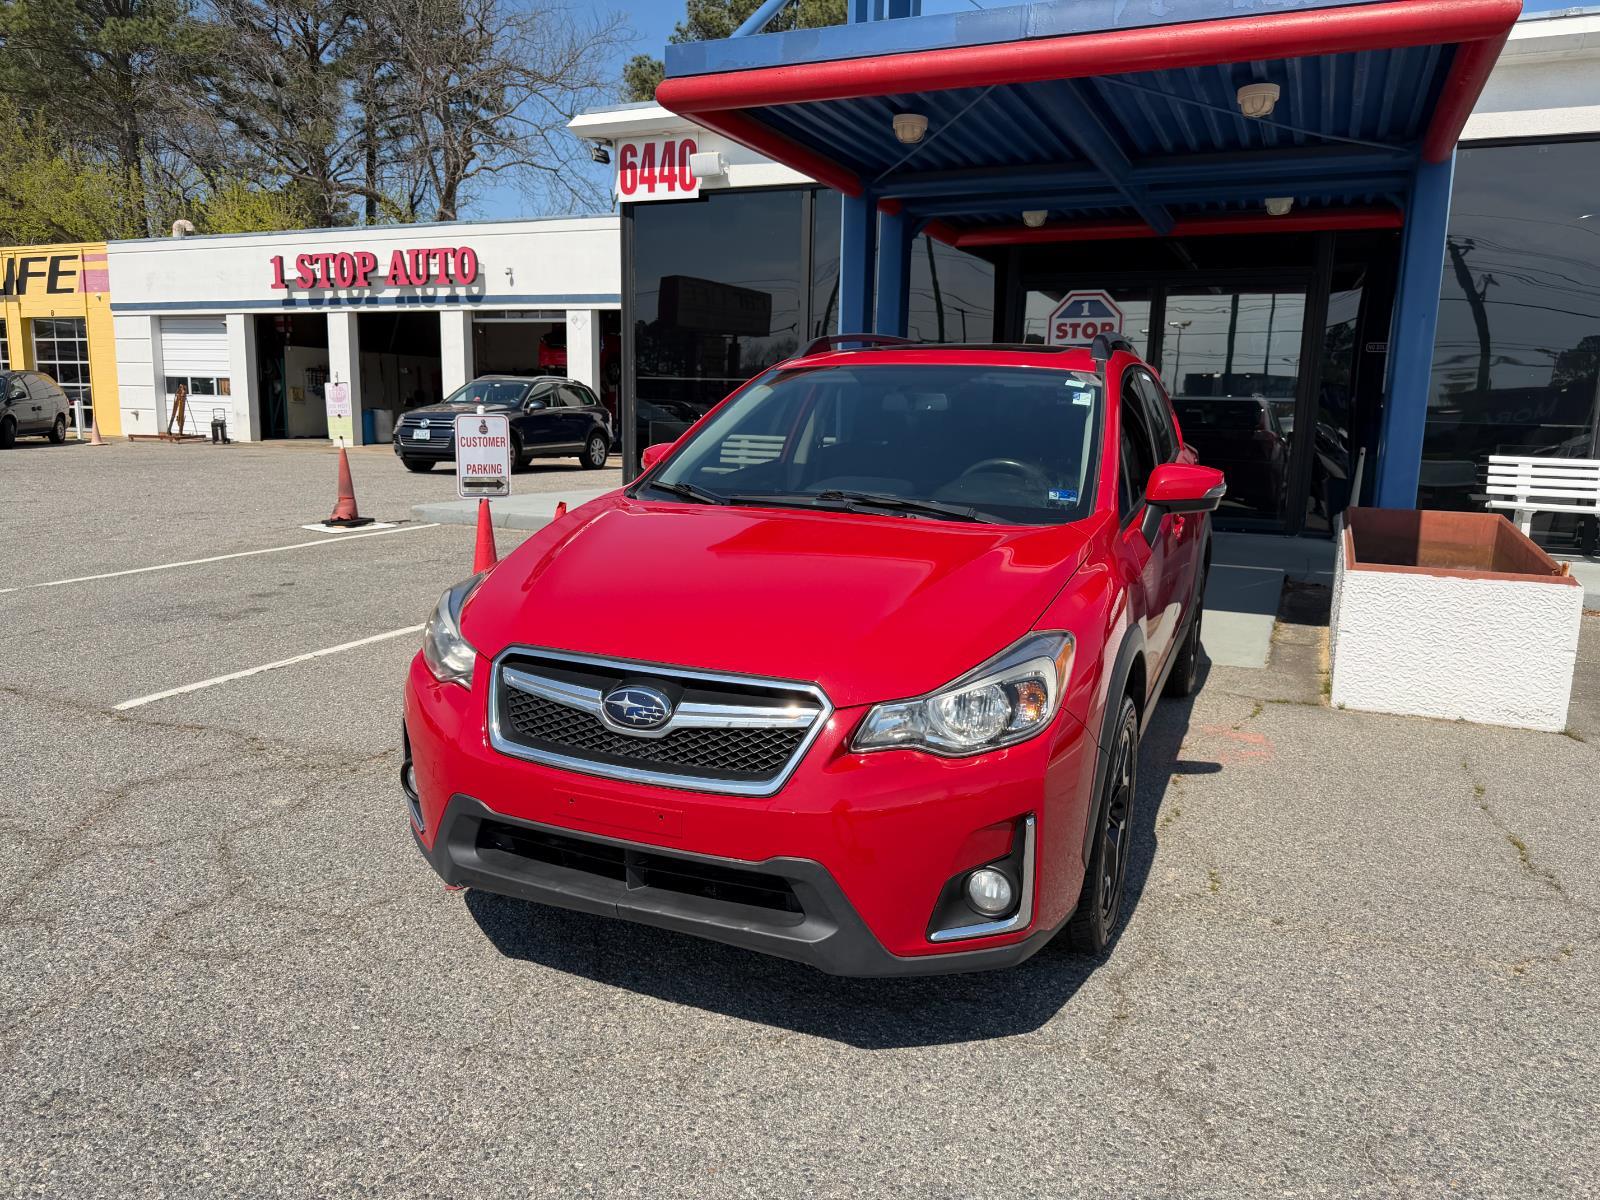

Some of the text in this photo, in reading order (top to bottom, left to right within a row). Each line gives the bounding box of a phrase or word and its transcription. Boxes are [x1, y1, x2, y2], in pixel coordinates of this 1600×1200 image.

[620, 138, 697, 195] 6440
[0, 255, 78, 295] IFE
[270, 246, 476, 289] 1 STOP AUTO
[1080, 301, 1091, 316] 1
[460, 436, 506, 448] CUSTOMER
[466, 463, 502, 475] PARKING
